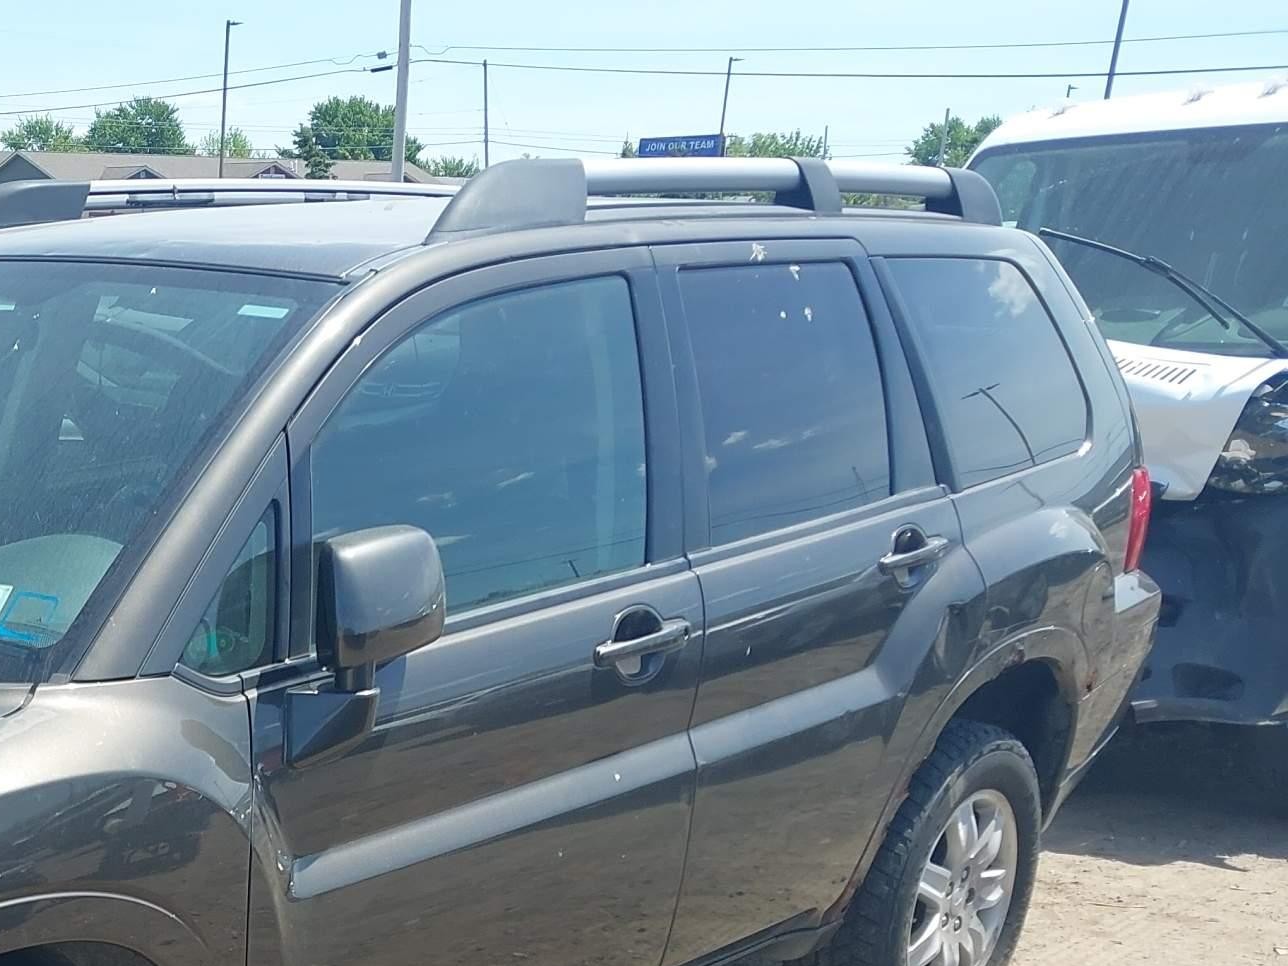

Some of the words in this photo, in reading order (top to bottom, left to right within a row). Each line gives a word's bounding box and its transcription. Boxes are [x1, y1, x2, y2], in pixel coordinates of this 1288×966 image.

[646, 143, 665, 152] JOIN
[668, 142, 686, 150] OUR
[690, 140, 714, 149] TEAM
